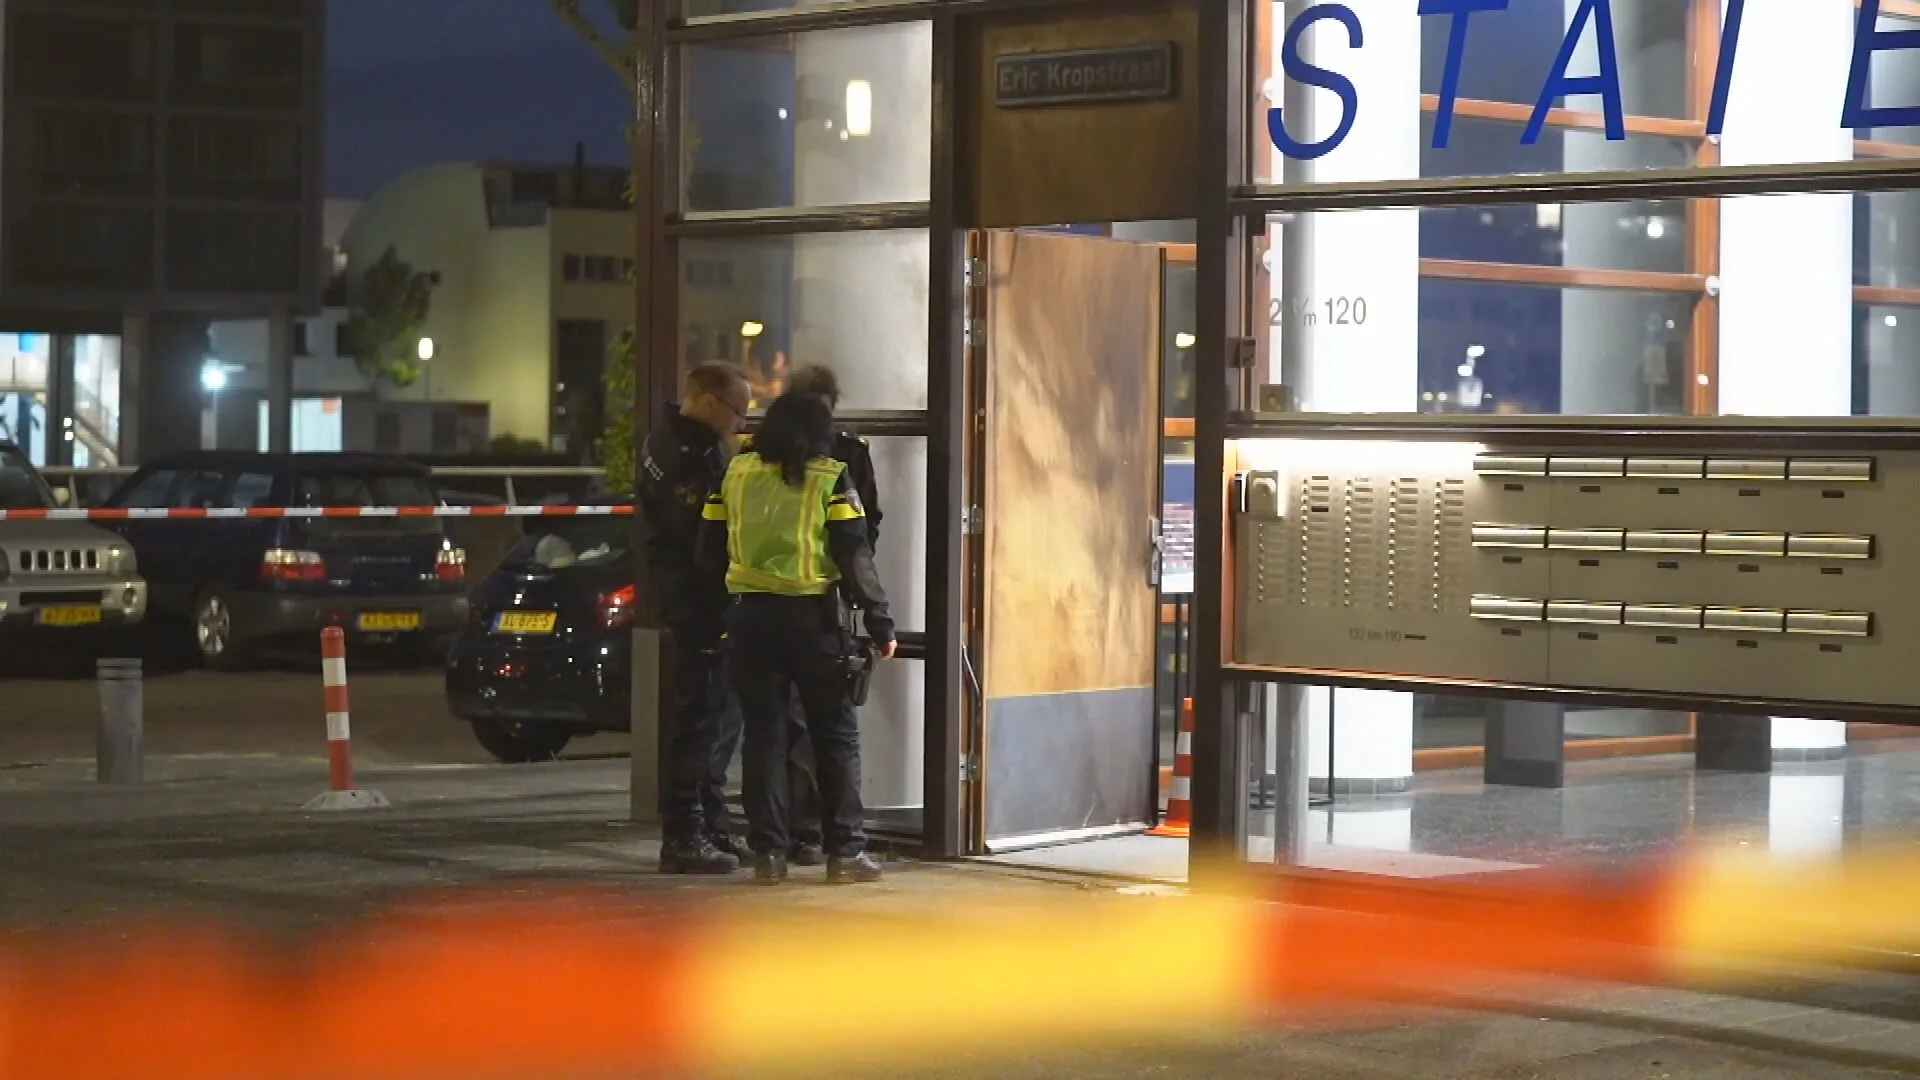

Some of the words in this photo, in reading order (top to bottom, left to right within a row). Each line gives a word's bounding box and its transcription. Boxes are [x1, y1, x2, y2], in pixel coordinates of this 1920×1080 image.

[999, 65, 1040, 93] Eric
[1046, 56, 1162, 93] Kropstraat
[1324, 296, 1367, 326] 120
